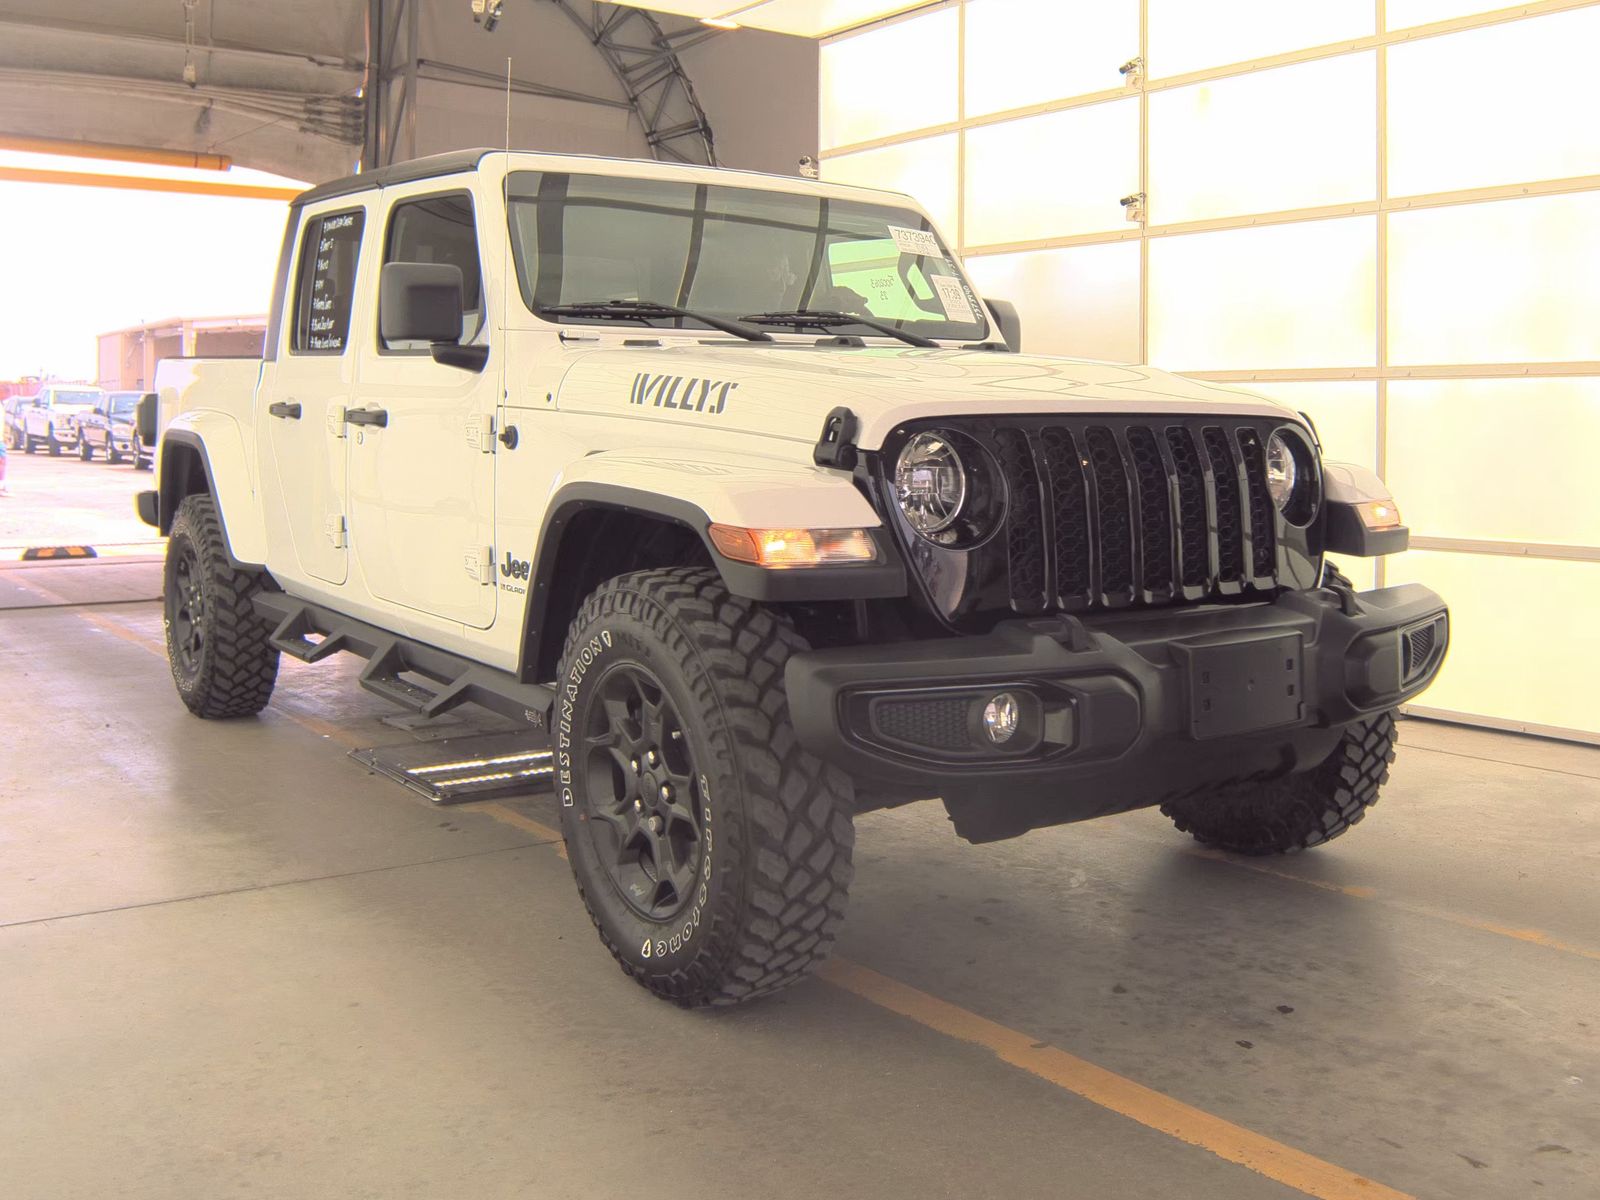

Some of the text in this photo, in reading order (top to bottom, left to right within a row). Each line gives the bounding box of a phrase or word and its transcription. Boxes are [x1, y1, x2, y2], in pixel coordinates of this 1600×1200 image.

[630, 372, 739, 414] WILLYS
[500, 551, 531, 581] Jee
[559, 636, 602, 807] DESTINATION
